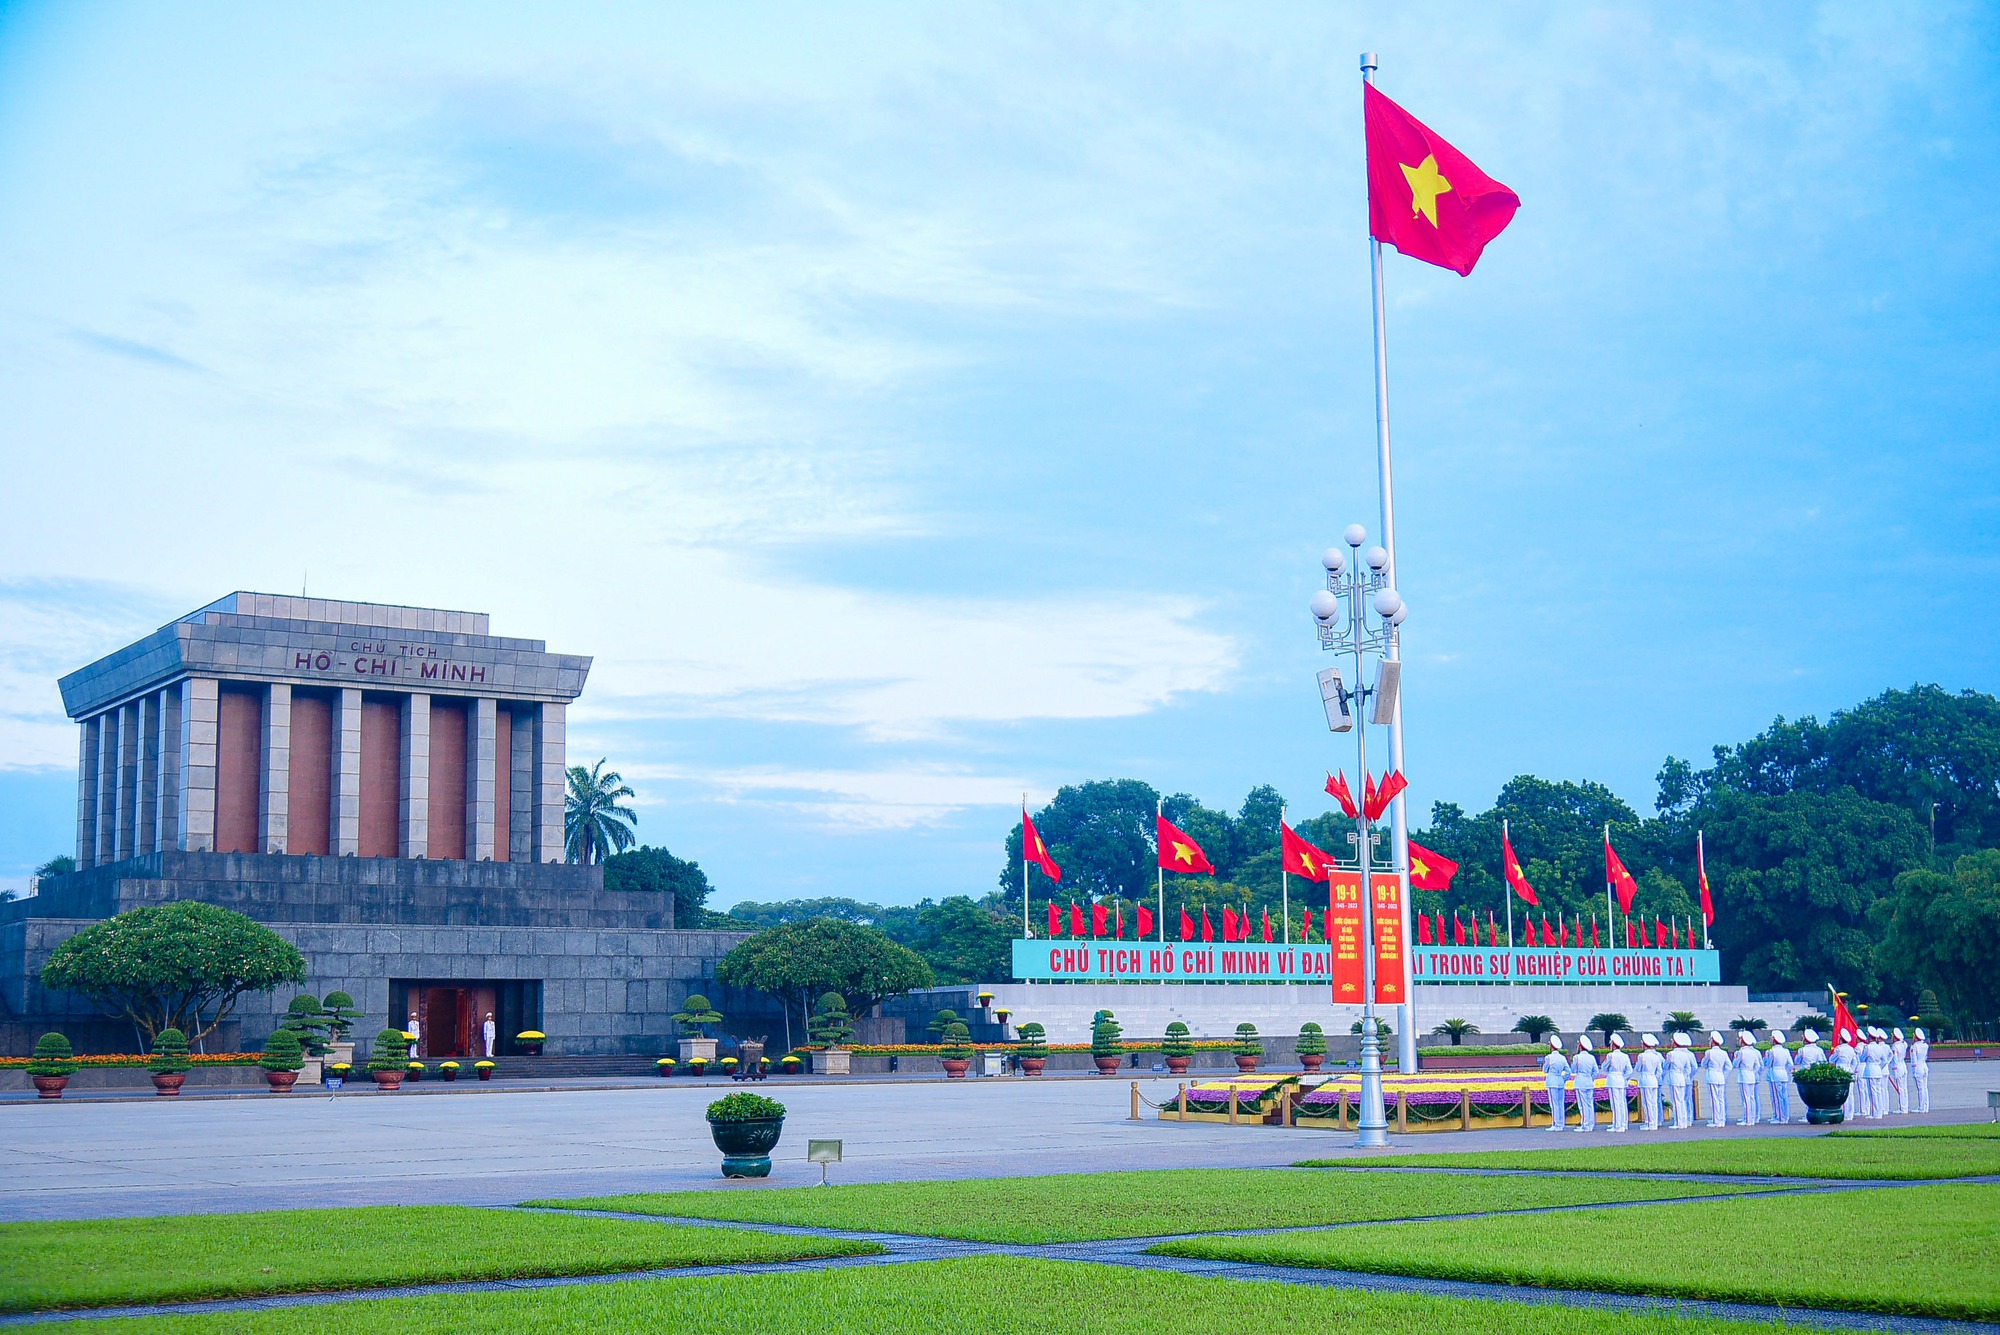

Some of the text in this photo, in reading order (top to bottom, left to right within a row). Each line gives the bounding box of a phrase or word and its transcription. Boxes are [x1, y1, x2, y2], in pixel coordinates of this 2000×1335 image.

[351, 639, 386, 653] CHỦ
[295, 650, 333, 671] HỒ
[354, 655, 401, 676] CHÍ
[420, 659, 486, 682] MINH
[1336, 884, 1356, 900] 19-8
[1377, 885, 1396, 901] 19-8
[1049, 942, 1089, 973] CHỦ
[1098, 949, 1141, 978] TỊCH
[1149, 943, 1175, 973] HỒ
[1182, 946, 1214, 974] CHÍ
[1222, 951, 1269, 975] MINH
[1277, 947, 1295, 974] VĨ
[1302, 951, 1331, 978] ĐẠI
[1430, 953, 1483, 976] TRONG
[1490, 950, 1511, 979] SỰ
[1516, 951, 1572, 979] NGHIỆP
[1578, 949, 1607, 976] CỦA
[1612, 950, 1661, 976] CHÚNG
[1666, 954, 1685, 976] TA
[1688, 955, 1694, 977] !
